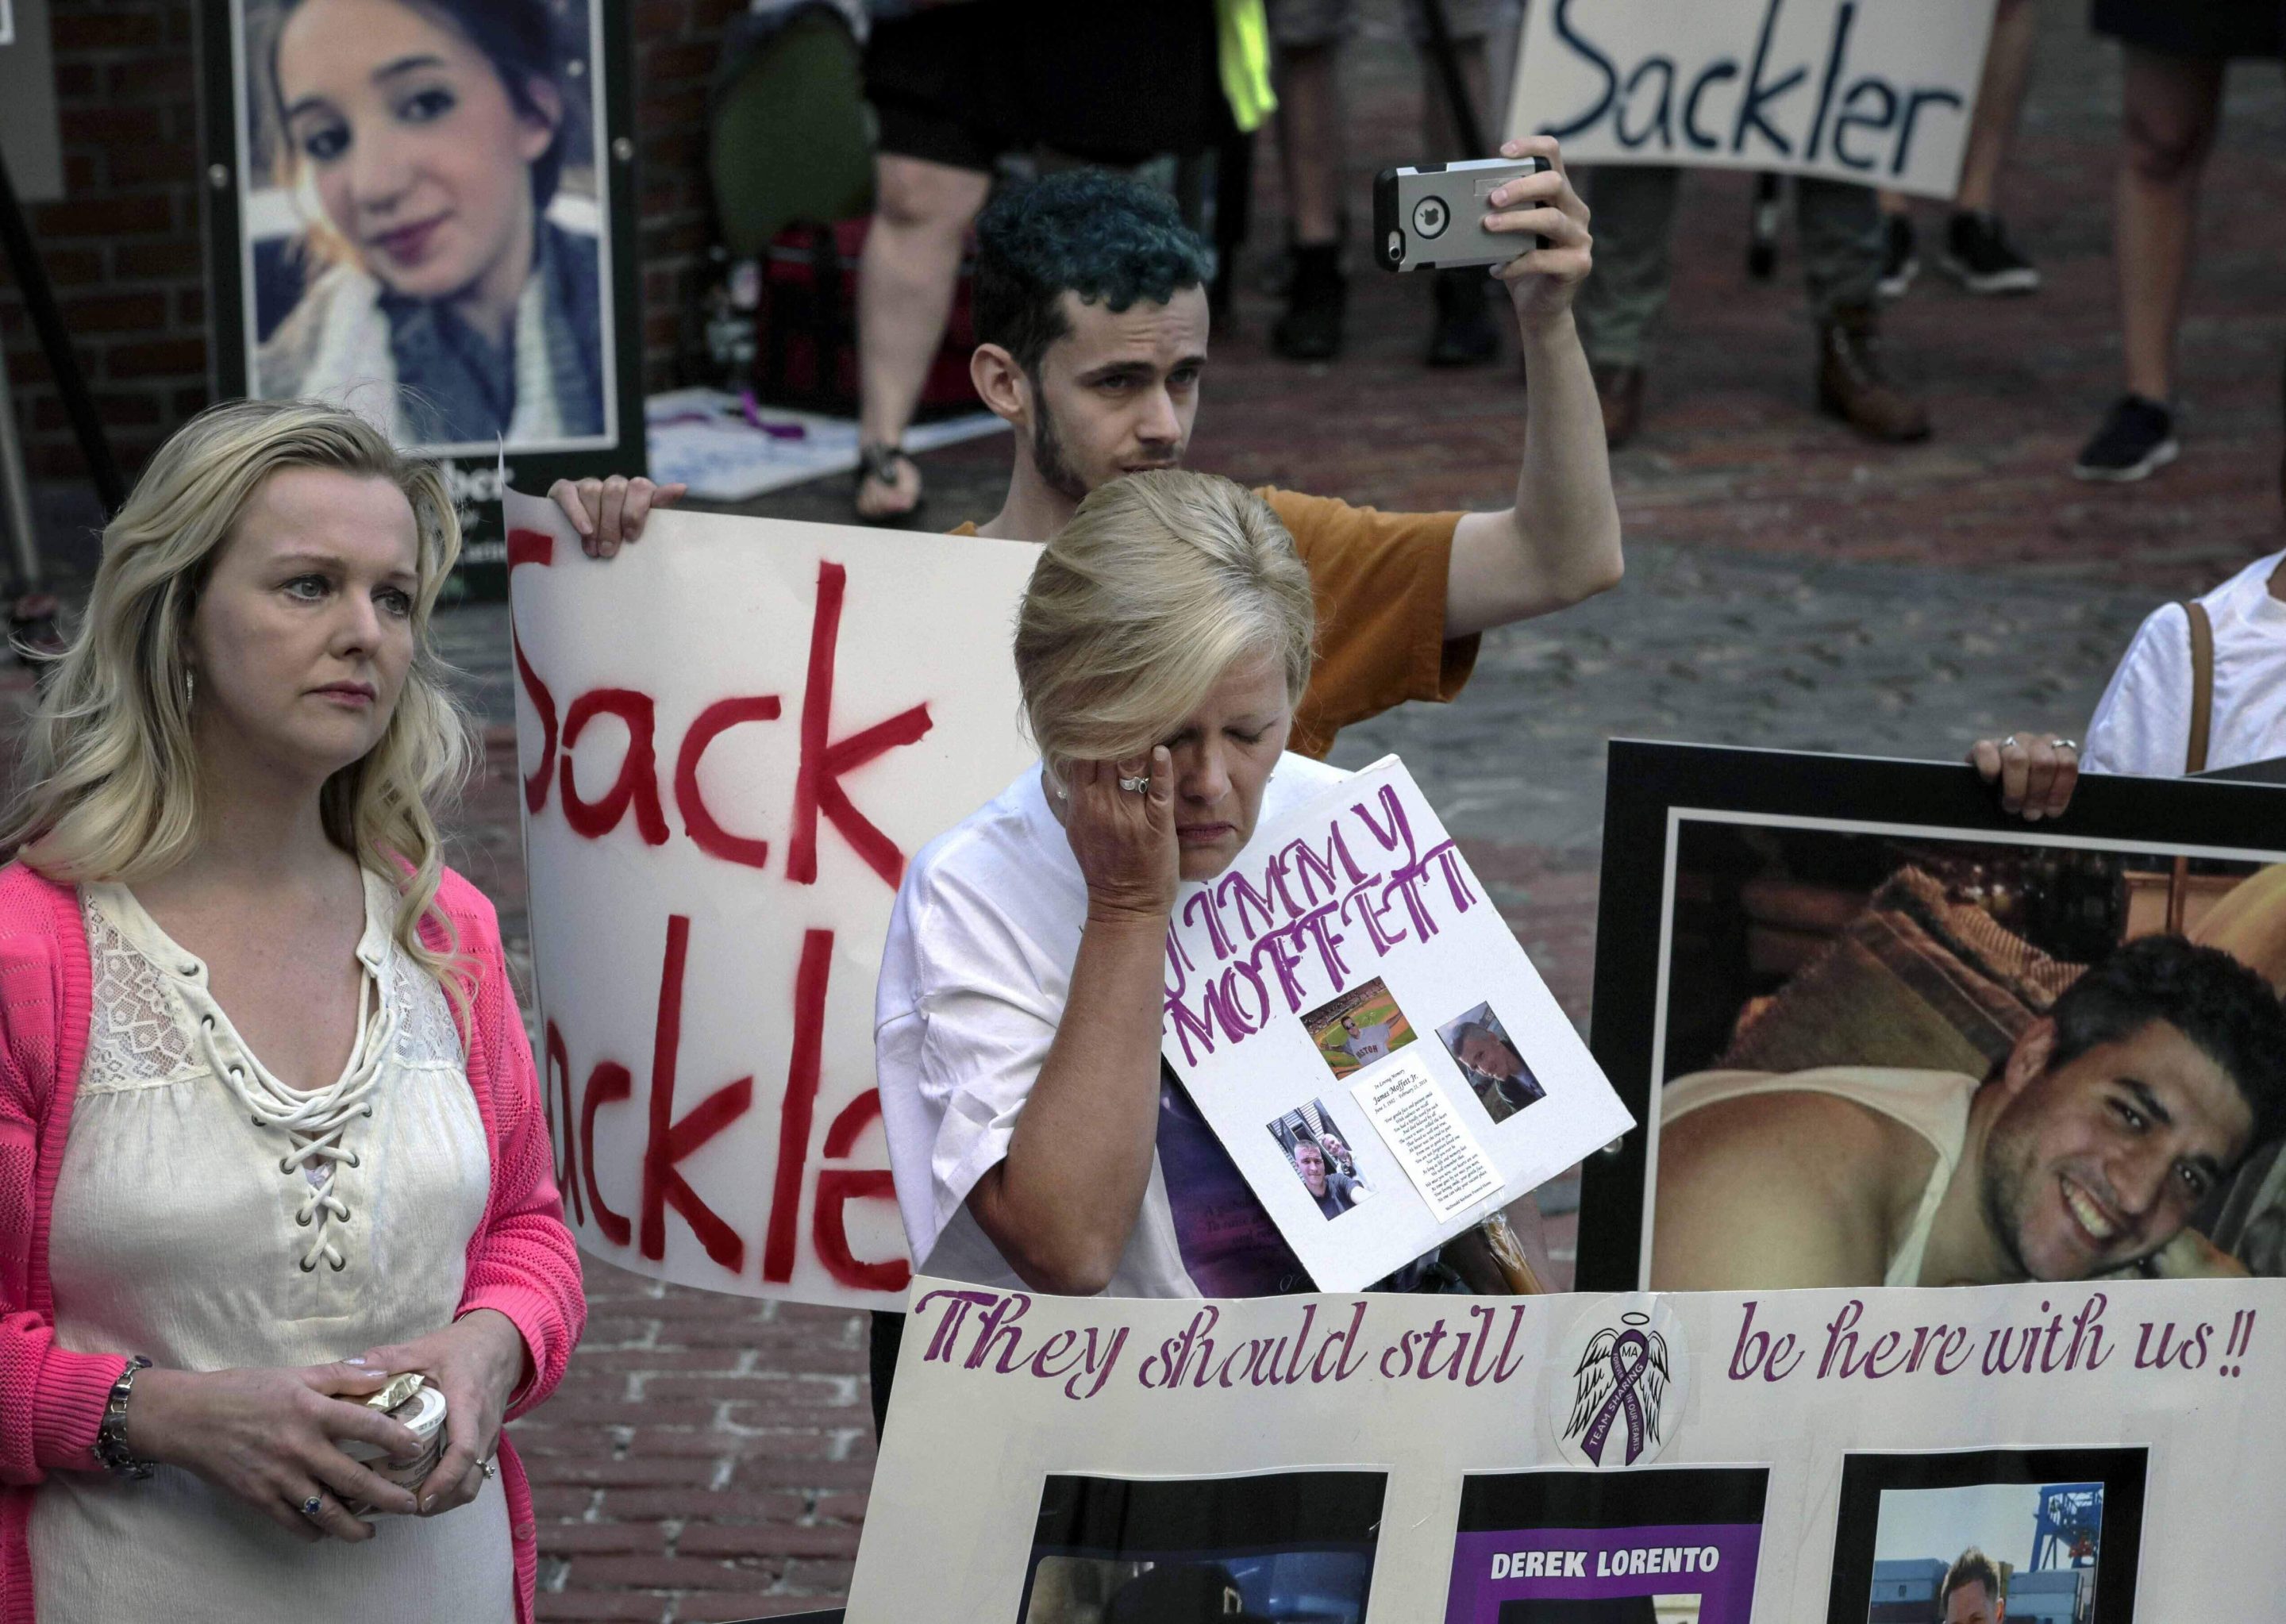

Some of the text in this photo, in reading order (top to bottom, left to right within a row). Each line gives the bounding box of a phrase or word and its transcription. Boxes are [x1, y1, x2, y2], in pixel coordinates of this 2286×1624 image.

[1537, 0, 1964, 176] Sackler
[1164, 784, 1417, 999] JIMMY
[1164, 839, 1477, 1068] MOFFETT
[1372, 1074, 1418, 1106] James Moffett Jr.
[1379, 1077, 1392, 1087] Loving
[1391, 1069, 1405, 1079] Memory
[546, 915, 912, 1291] ackle
[1374, 1106, 1384, 1114] June
[1398, 1087, 1414, 1099] February
[1415, 1116, 1428, 1126] beloved
[1414, 1134, 1423, 1143] loved
[1445, 1137, 1455, 1145] loved
[1443, 1158, 1457, 1169] remember
[1449, 1149, 1461, 1158] memory
[915, 1291, 1130, 1400] They
[1138, 1304, 1368, 1389] should
[1380, 1305, 1526, 1387] still
[1728, 1302, 1806, 1383] be
[1816, 1299, 1976, 1380] here
[1980, 1293, 2116, 1375] with
[1622, 1346, 1638, 1357] MA
[1613, 1353, 1625, 1380] FOREVER
[1589, 1364, 1644, 1446] TEAM SHARING
[1626, 1393, 1640, 1452] IN OUR HEARTS
[1491, 1546, 1719, 1580] DEREK LORENTO
